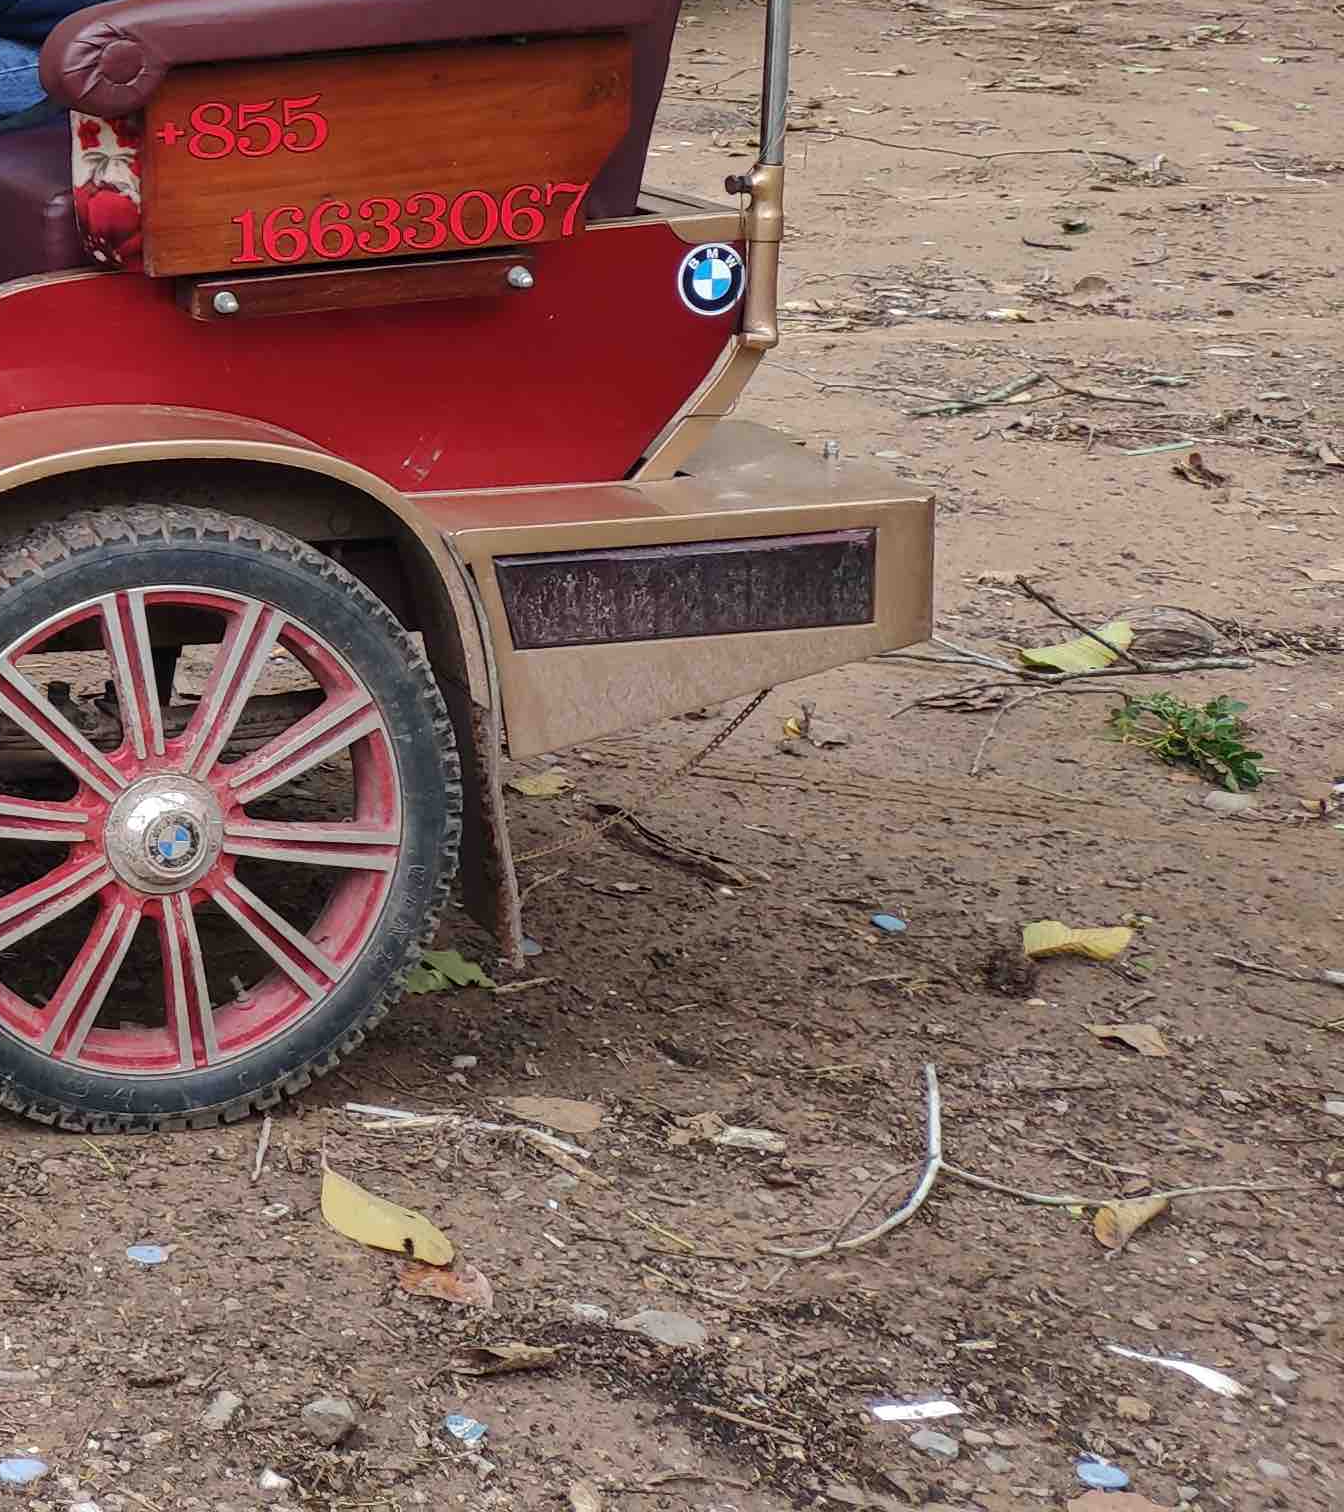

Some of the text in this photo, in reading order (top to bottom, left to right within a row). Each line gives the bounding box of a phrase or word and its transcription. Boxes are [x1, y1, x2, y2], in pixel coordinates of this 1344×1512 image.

[155, 93, 328, 160] +855
[231, 181, 591, 264] 16633067
[687, 247, 738, 270] BMW
